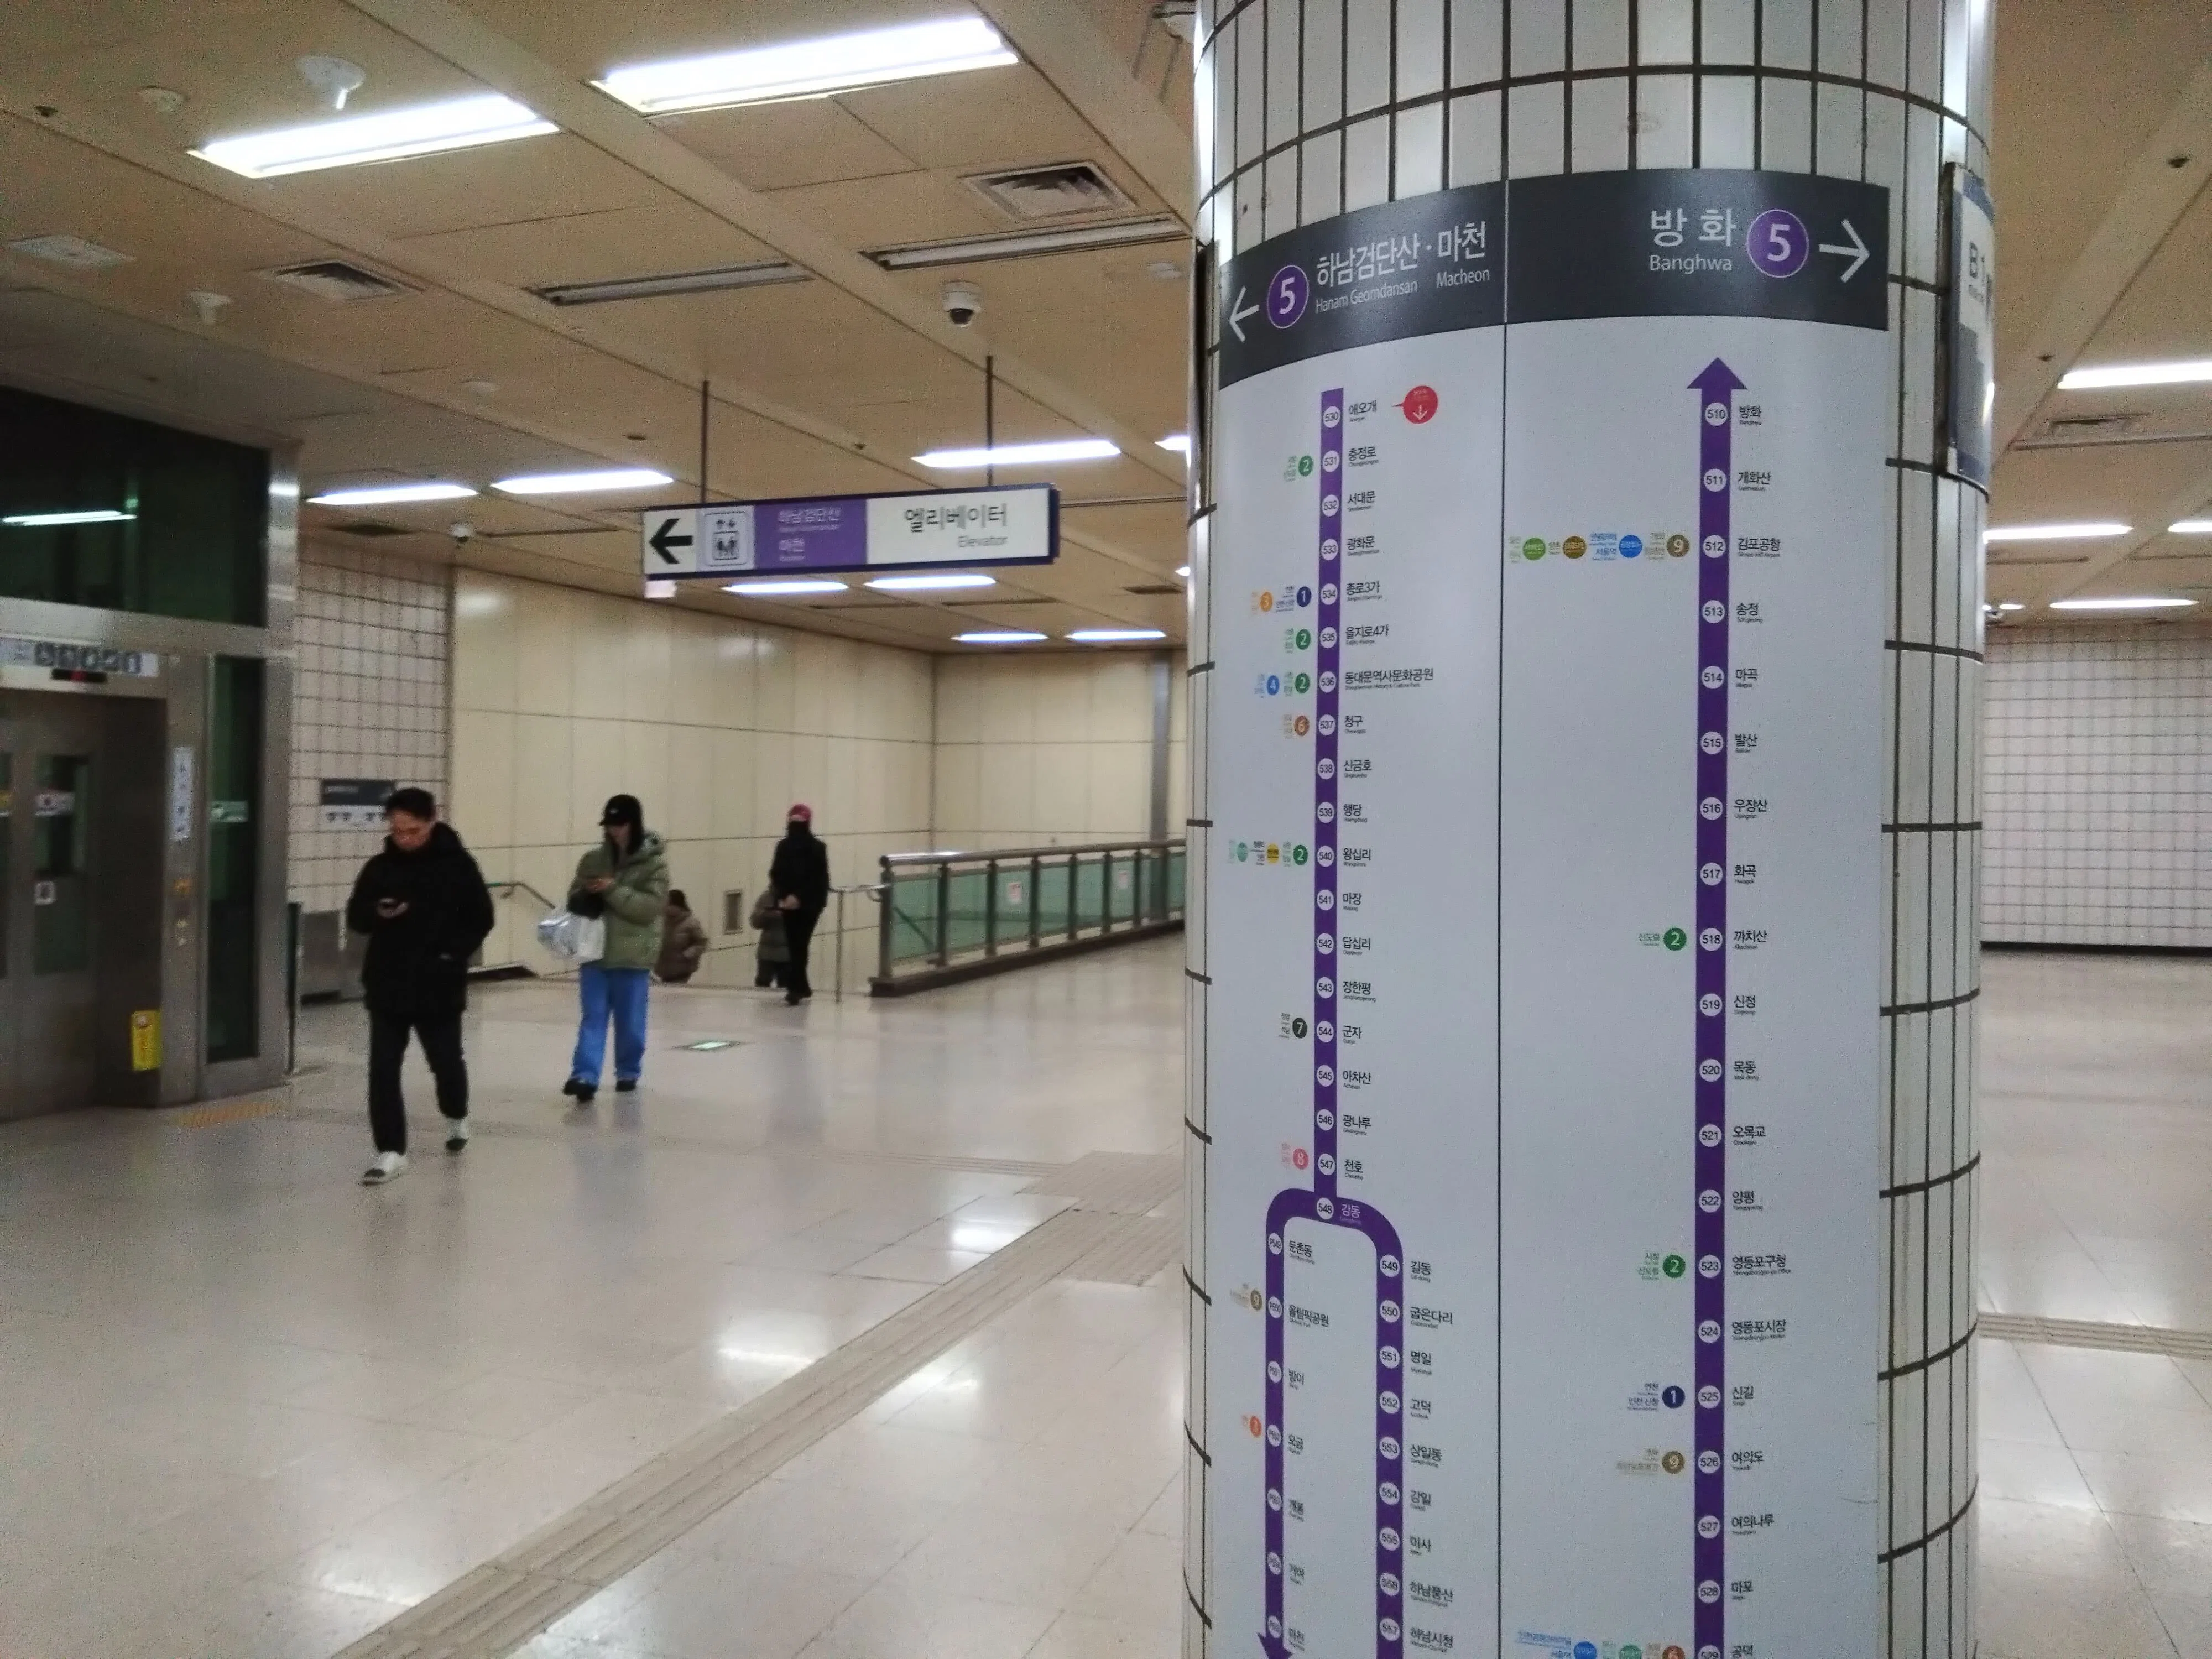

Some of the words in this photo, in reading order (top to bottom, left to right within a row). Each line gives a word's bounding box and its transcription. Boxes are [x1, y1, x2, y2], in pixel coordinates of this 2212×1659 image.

[1437, 220, 1486, 263] 마천
[1767, 223, 1791, 262] 5
[1649, 254, 1733, 275] Banghwa
[1437, 268, 1490, 289] Macheon
[1279, 275, 1296, 315] 5
[1316, 295, 1349, 314] Hanam
[1350, 279, 1418, 305] Geomdansan
[1349, 400, 1377, 416] 애오개
[1707, 409, 1726, 419] 510
[1739, 405, 1762, 419] 방화
[1325, 412, 1338, 422] 530
[1348, 446, 1376, 461] 충정로
[1324, 457, 1337, 466] 531
[1706, 475, 1723, 484] 511
[1738, 471, 1771, 485] 개화산
[1347, 491, 1376, 505] 서대문
[1324, 500, 1337, 510] 532
[904, 503, 1008, 533] 엘리베이터
[957, 534, 1008, 548] Elevator
[1347, 536, 1375, 550] 광화문
[1705, 542, 1724, 551] 512
[1738, 538, 1781, 552] 김포공항
[1323, 589, 1335, 599] 534
[1347, 581, 1380, 596] 종로3가
[1705, 607, 1724, 617] 513
[1736, 602, 1759, 616] 송정
[1345, 624, 1389, 640] 을지로4가
[1345, 668, 1434, 685] 동대문역사문화공원
[1704, 672, 1723, 682] 514
[1735, 667, 1759, 681] 마곡
[1320, 720, 1333, 729] 537
[1344, 716, 1363, 728] 청구
[1703, 738, 1721, 748] 515
[1735, 733, 1758, 747] 발산
[1344, 759, 1372, 772] 신금호
[1343, 804, 1363, 817] 행당
[1703, 804, 1721, 813] 516
[1733, 799, 1768, 812] 우장산
[1319, 808, 1333, 817] 539
[1319, 852, 1332, 860] 540
[1343, 848, 1371, 861] 왕십리
[1703, 869, 1720, 879] 517
[1734, 864, 1757, 877] 화곡
[1318, 895, 1332, 904] 541
[1343, 893, 1362, 905] 마장
[1702, 935, 1720, 945] 518
[1734, 929, 1767, 943] 까치산
[1318, 940, 1332, 948] 542
[1343, 937, 1371, 951] 답십리
[1318, 983, 1332, 992] 543
[1343, 981, 1371, 995] 장한평
[1702, 1000, 1720, 1010] 519
[1733, 995, 1756, 1009] 신정
[1318, 1027, 1332, 1036] 544
[1342, 1025, 1363, 1039] 군자
[1702, 1065, 1720, 1074] 520
[1733, 1061, 1756, 1074] 목동
[1318, 1071, 1332, 1081] 545
[1342, 1070, 1371, 1085] 아차산
[1318, 1115, 1332, 1125] 546
[1343, 1114, 1371, 1129] 광나루
[1702, 1131, 1718, 1140] 521
[1732, 1125, 1766, 1139] 오목교
[1320, 1160, 1333, 1169] 547
[1344, 1159, 1363, 1173] 천호
[1701, 1197, 1719, 1206] 522
[1732, 1190, 1755, 1204] 양평
[1318, 1203, 1332, 1214] 548
[1341, 1203, 1361, 1218] 강동
[1289, 1240, 1312, 1258] 둔촌동
[1382, 1260, 1397, 1271] 549
[1410, 1261, 1432, 1276] 길동
[1701, 1261, 1719, 1271] 523
[1732, 1254, 1786, 1270] 영등포구청
[1289, 1304, 1329, 1327] 올림픽공원
[1382, 1306, 1398, 1317] 550
[1410, 1306, 1453, 1325] 굽은다리
[1701, 1327, 1718, 1337] 524
[1732, 1319, 1787, 1335] 영등포시장
[1382, 1351, 1397, 1362] 551
[1410, 1350, 1432, 1366] 명일
[1701, 1392, 1718, 1402] 525
[1732, 1385, 1754, 1400] 신길
[1382, 1397, 1397, 1408] 552
[1410, 1398, 1432, 1413] 고덕
[1700, 1457, 1718, 1467] 526
[1732, 1451, 1764, 1464] 여의도
[1700, 1522, 1718, 1532] 527
[1731, 1514, 1774, 1528] 여의나루
[1700, 1587, 1718, 1597] 528
[1731, 1580, 1754, 1593] 마포
